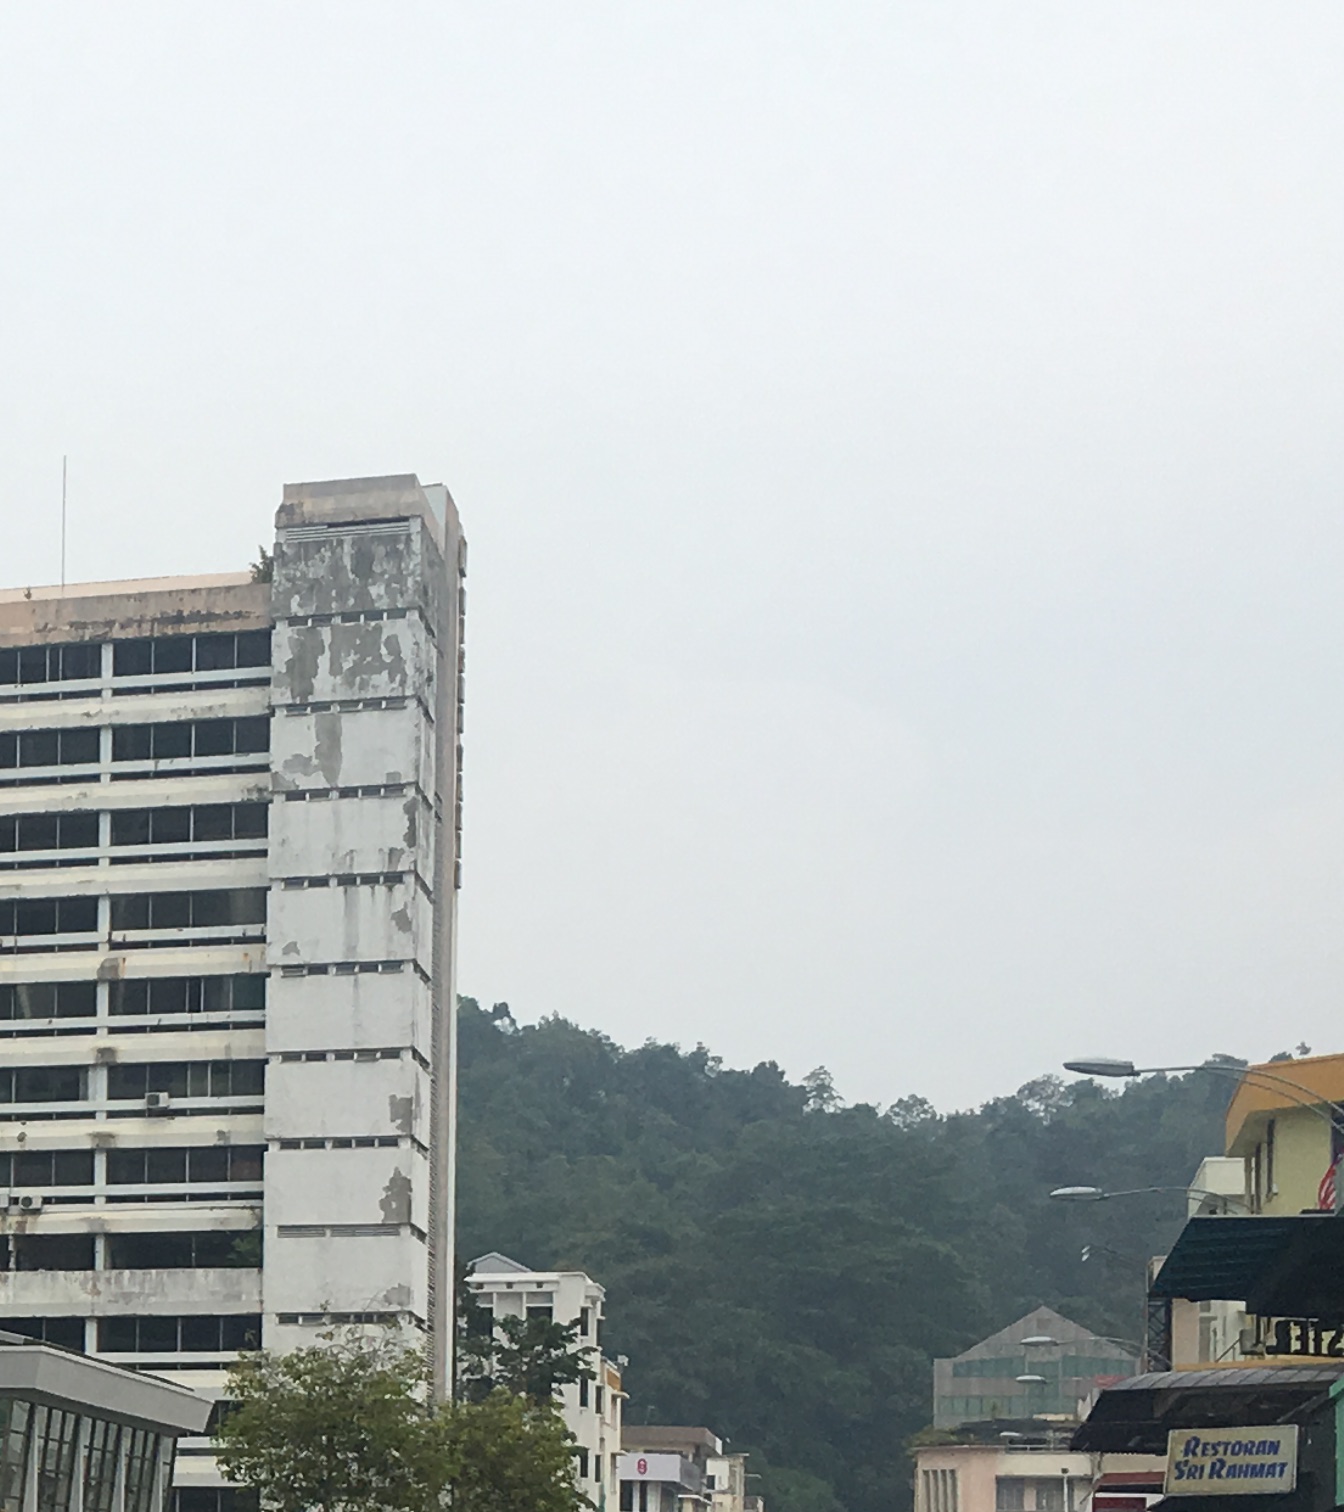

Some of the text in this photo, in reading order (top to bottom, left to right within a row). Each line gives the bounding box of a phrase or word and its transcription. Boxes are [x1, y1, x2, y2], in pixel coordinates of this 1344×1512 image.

[1182, 1436, 1281, 1462] RESTORAN
[1174, 1458, 1288, 1481] SRI RAHMAT
